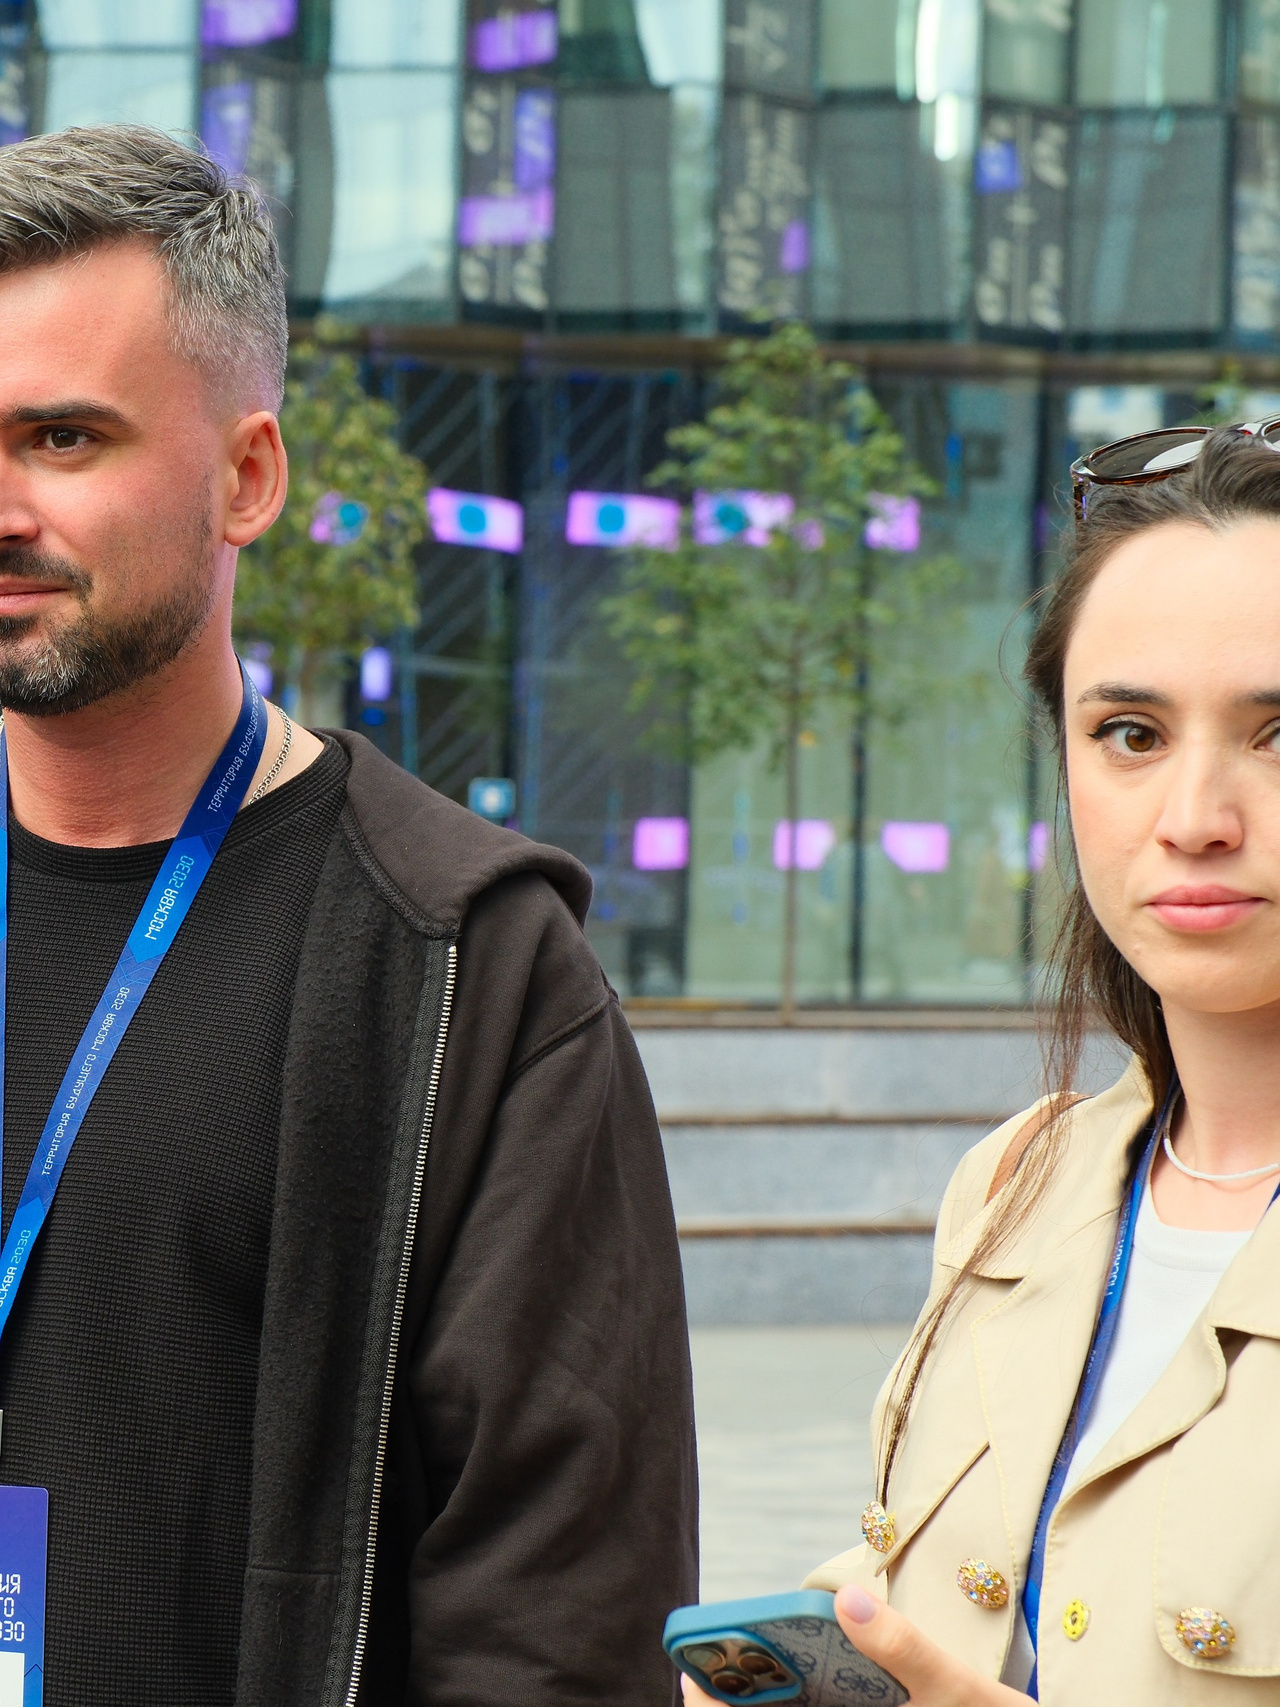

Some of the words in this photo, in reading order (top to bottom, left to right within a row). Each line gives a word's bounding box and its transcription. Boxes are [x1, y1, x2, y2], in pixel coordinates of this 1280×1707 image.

[207, 756, 244, 813] ТЕРРИТОРИЯ
[144, 888, 179, 940] МОСКВА
[167, 855, 195, 889] 2030
[41, 1113, 71, 1176] ТЕРРИТОРИЯ
[65, 1053, 97, 1110] БУДУЩЕГО
[91, 1013, 117, 1051] МОСКВА
[111, 986, 130, 1011] 2030
[11, 1229, 32, 1264] 2030
